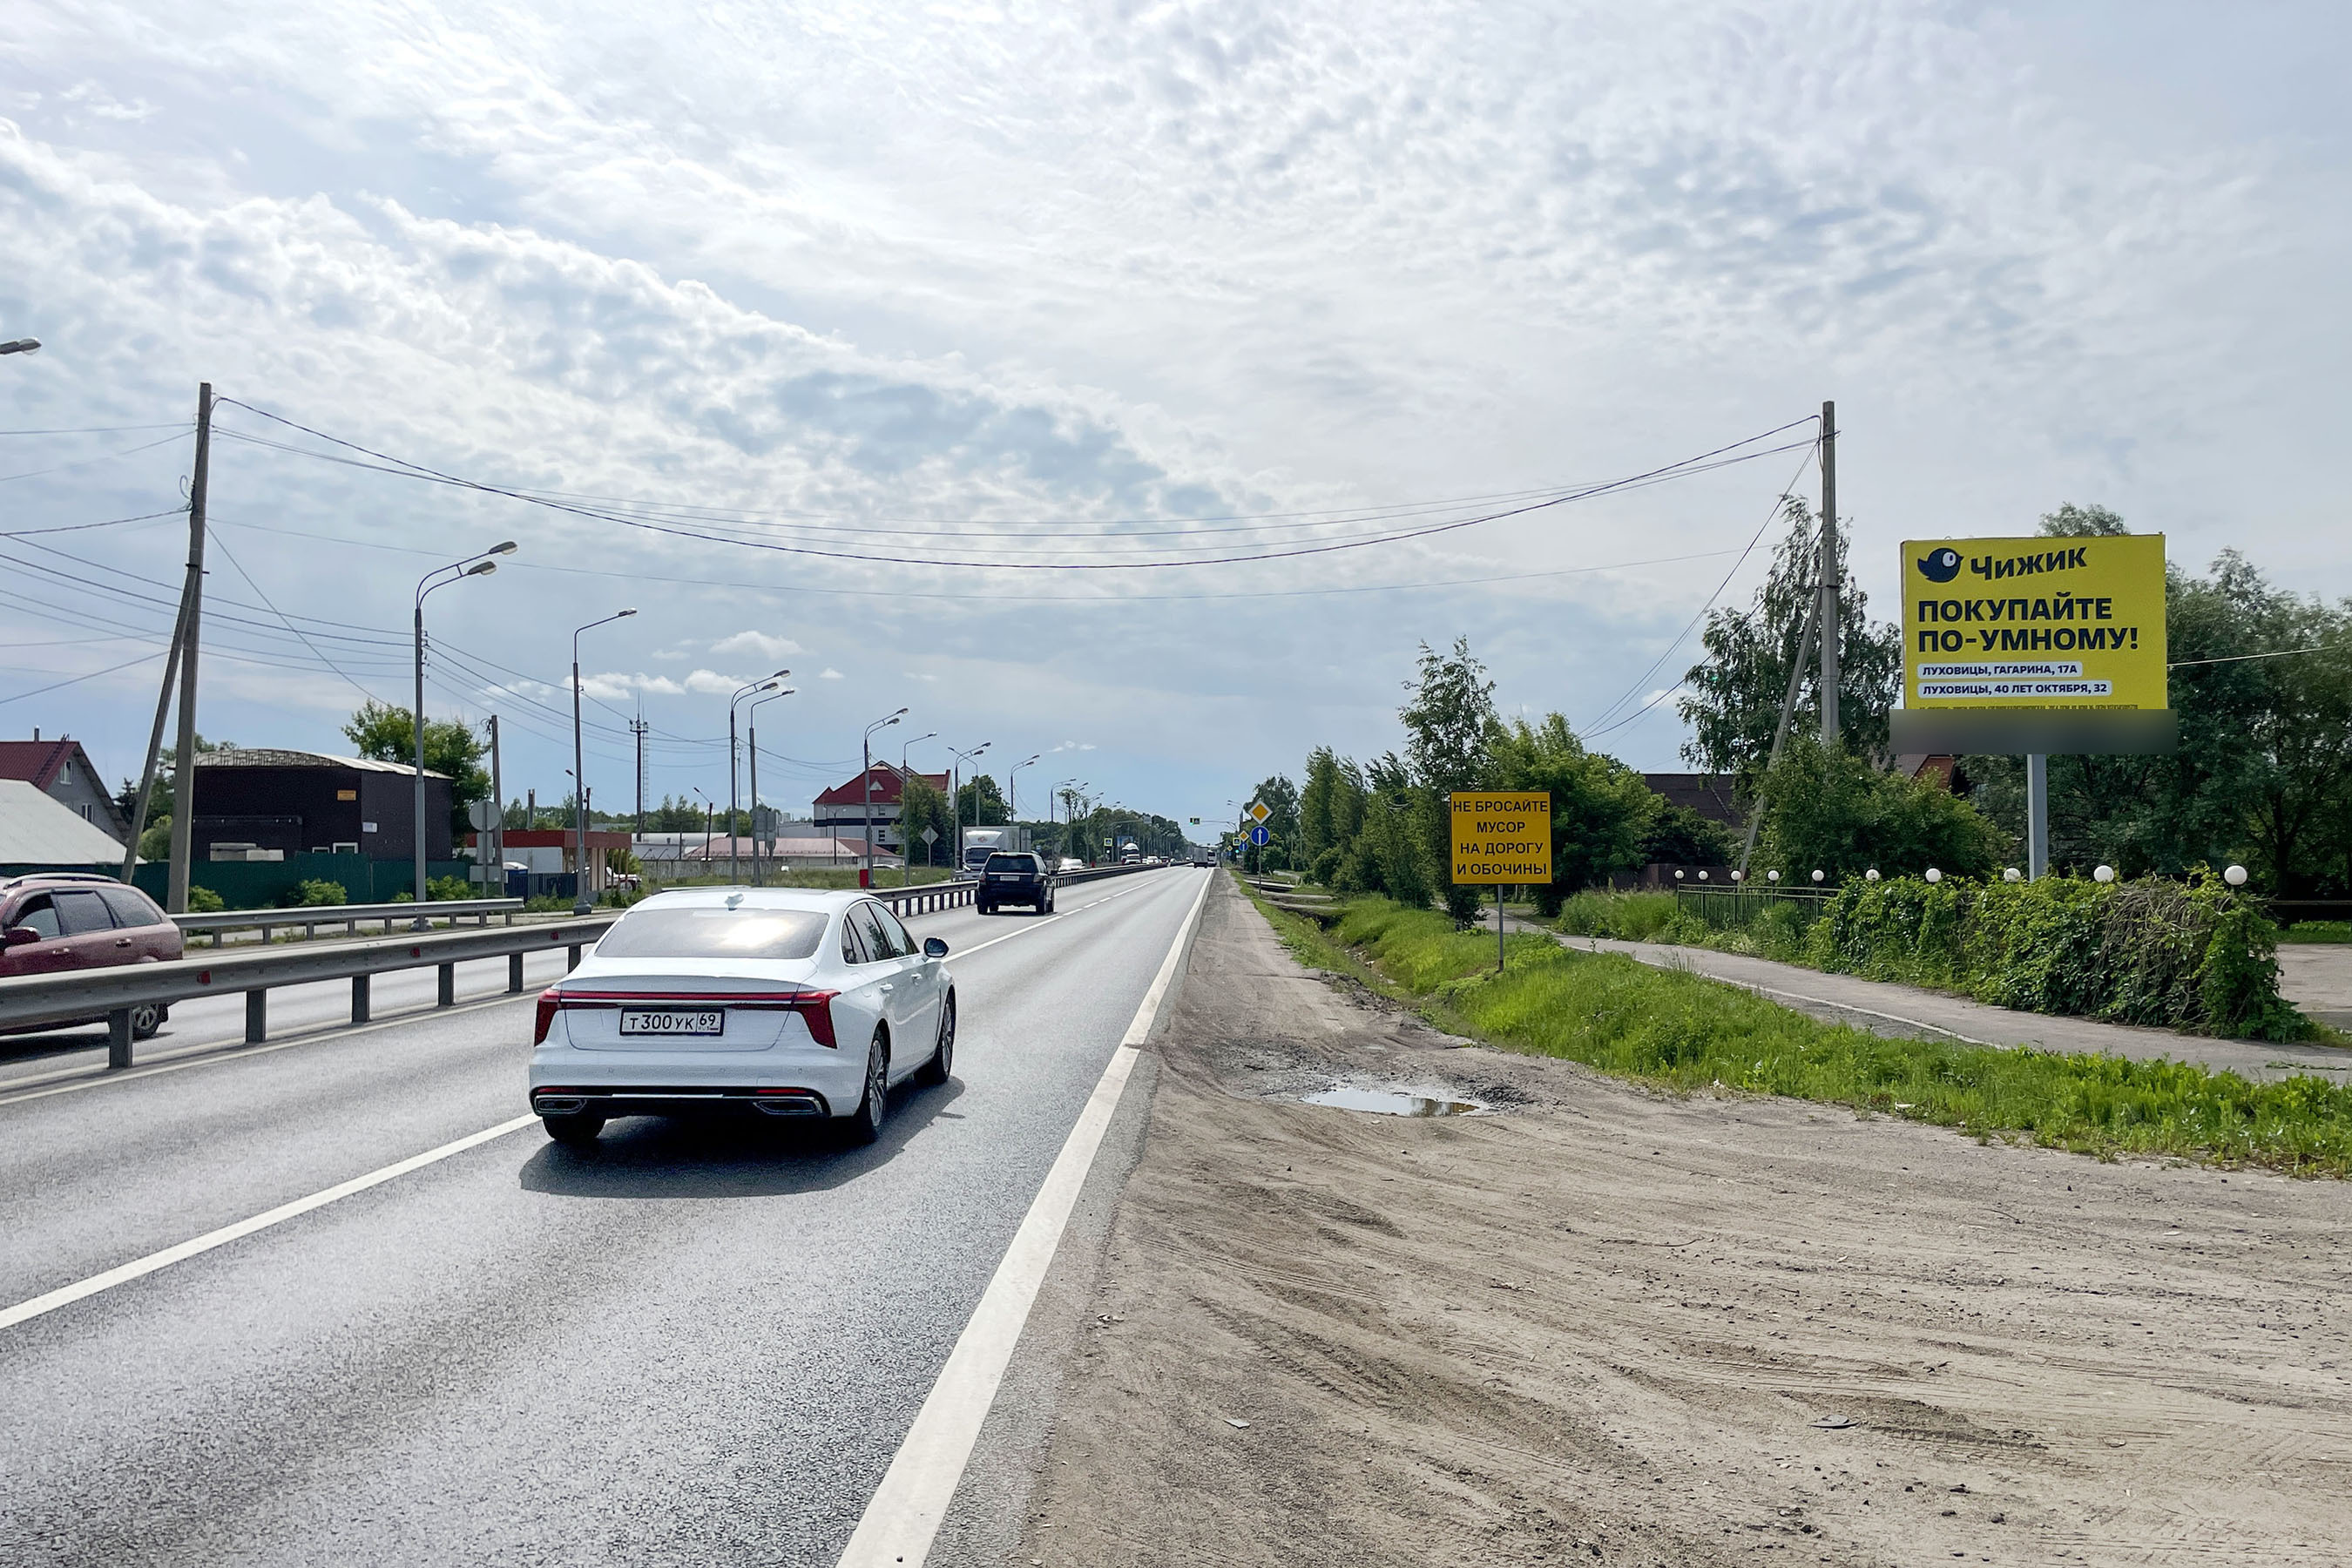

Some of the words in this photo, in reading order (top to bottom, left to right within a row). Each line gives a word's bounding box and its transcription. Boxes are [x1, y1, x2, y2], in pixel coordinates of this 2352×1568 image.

[1918, 591, 2112, 623] ПОКУПАЙТЕ
[1918, 627, 2139, 652] ПО-УМНОМУ!
[1923, 666, 1991, 676] ЛУХОВИЦЫ,
[1994, 665, 2055, 675] ГАГАРИНА,
[2058, 665, 2078, 673] 17А
[1923, 685, 1992, 695] ЛУХОВИЦЫ,
[1994, 685, 2009, 693] 40
[2011, 685, 2033, 693] ЛЕТ
[2036, 684, 2092, 694] ОКТЯБРЯ,
[2093, 684, 2107, 693] 32
[1453, 801, 1471, 812] НЕ
[1475, 799, 1548, 812] БРОСАЙТЕ
[1477, 821, 1525, 833] МУСОР
[1460, 842, 1480, 854] НА
[1484, 842, 1544, 856] ДОРОГУ
[1456, 863, 1466, 875] И
[1470, 863, 1547, 875] ОБОЧИНЫ
[700, 1014, 716, 1026] 69
